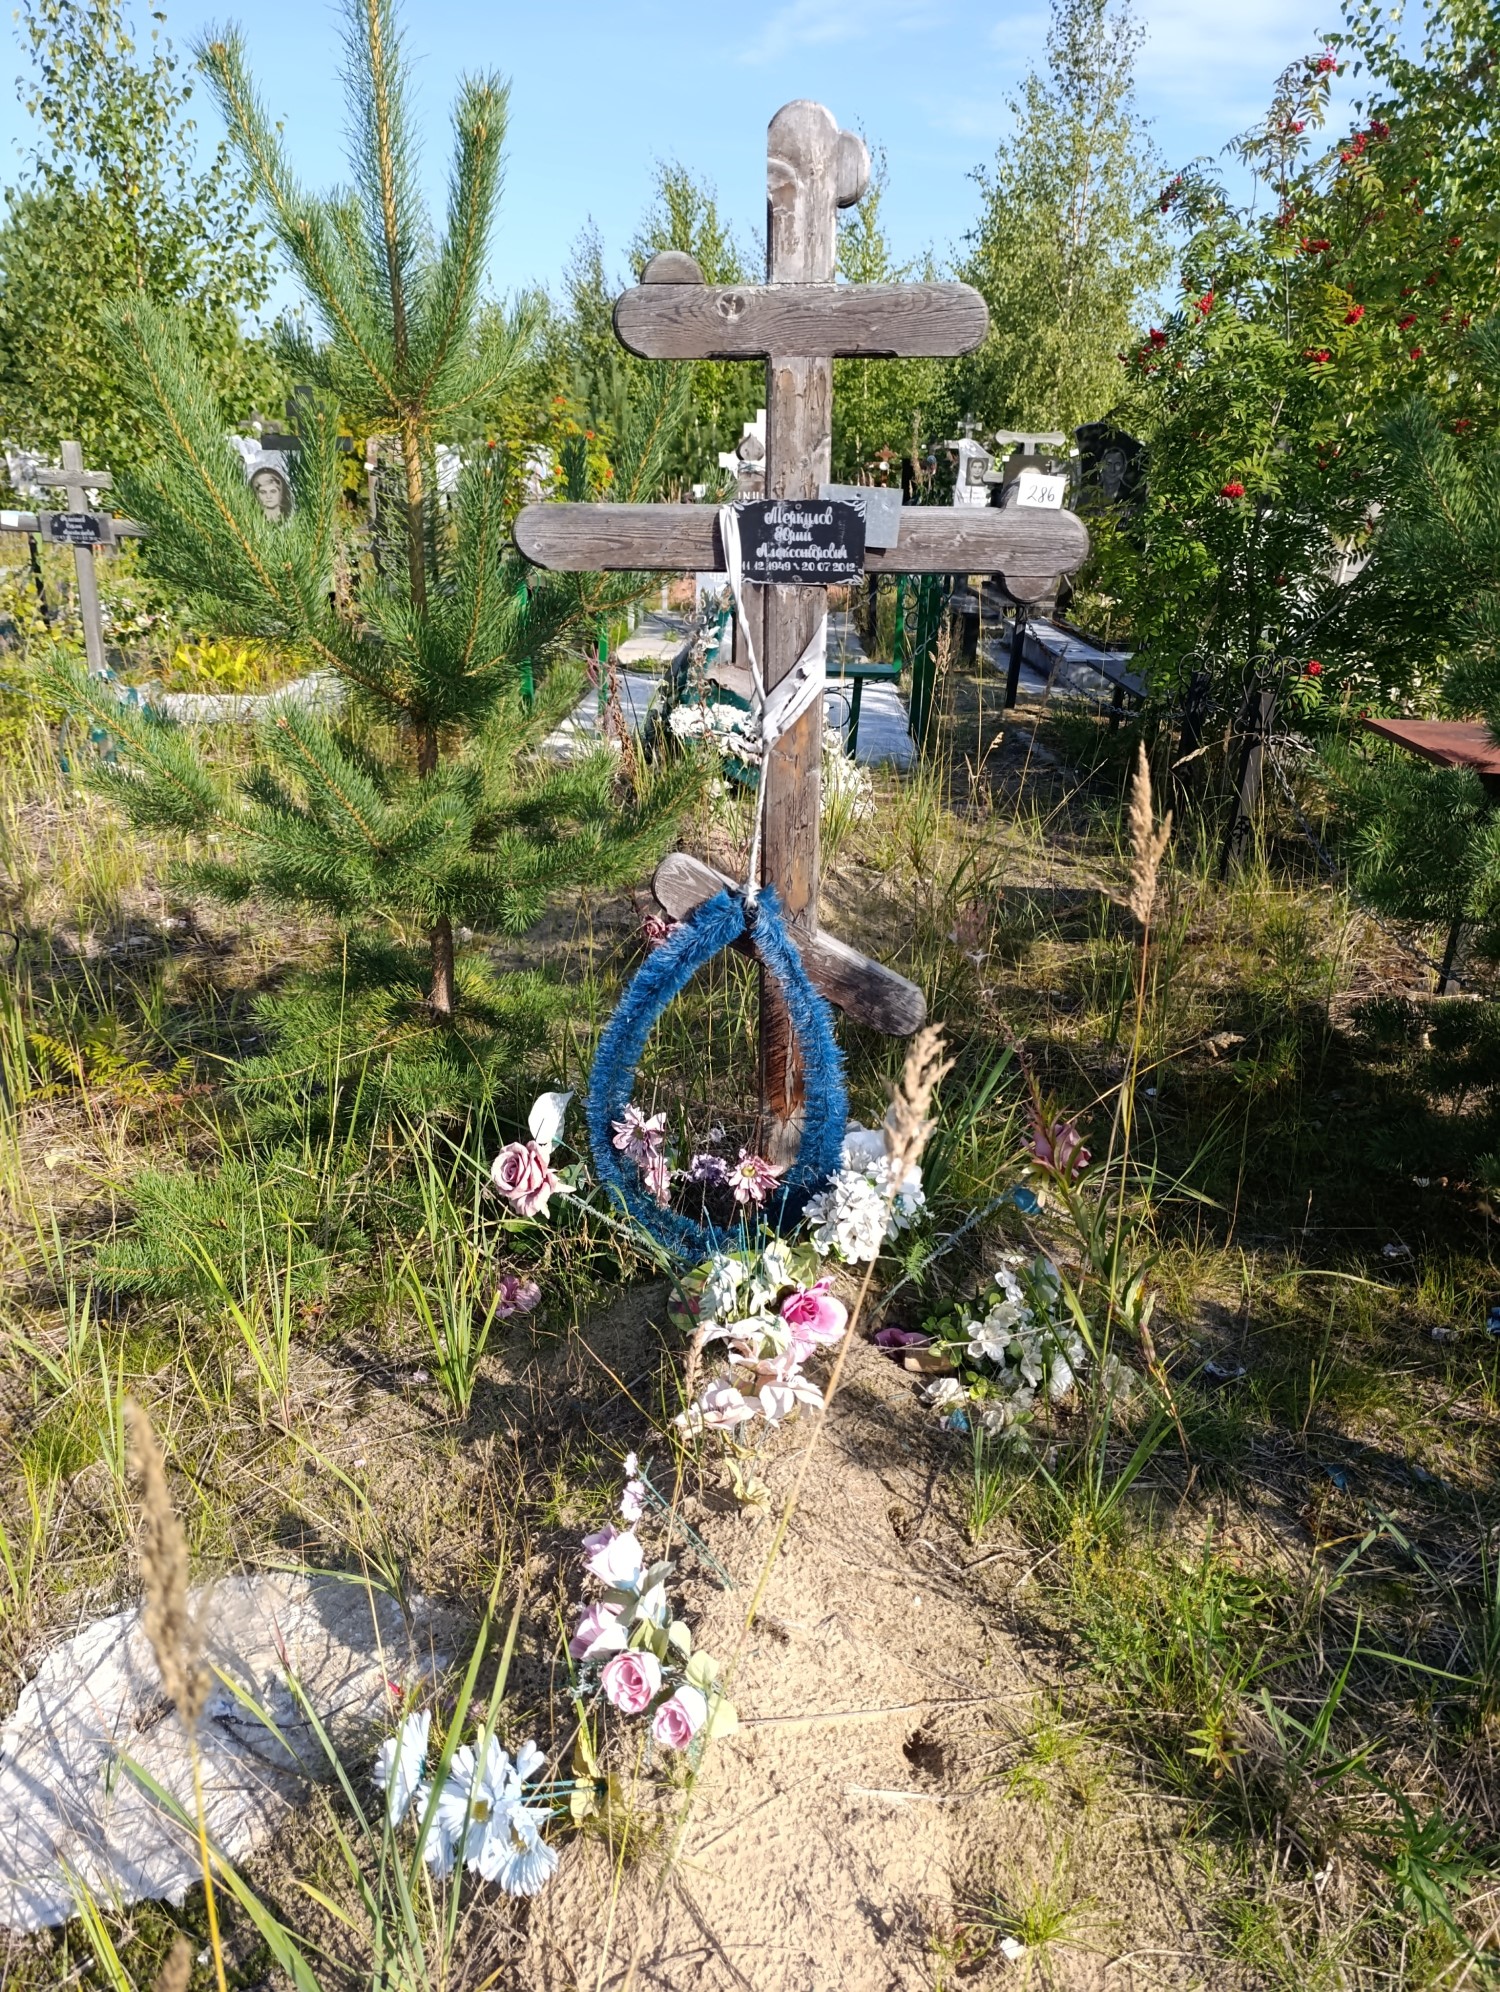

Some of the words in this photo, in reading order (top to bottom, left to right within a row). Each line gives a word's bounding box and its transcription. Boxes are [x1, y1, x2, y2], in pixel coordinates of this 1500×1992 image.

[1026, 485, 1055, 503] 286
[764, 506, 833, 529] Меркулов
[774, 526, 813, 545] Юрий
[756, 543, 848, 561] Александрович
